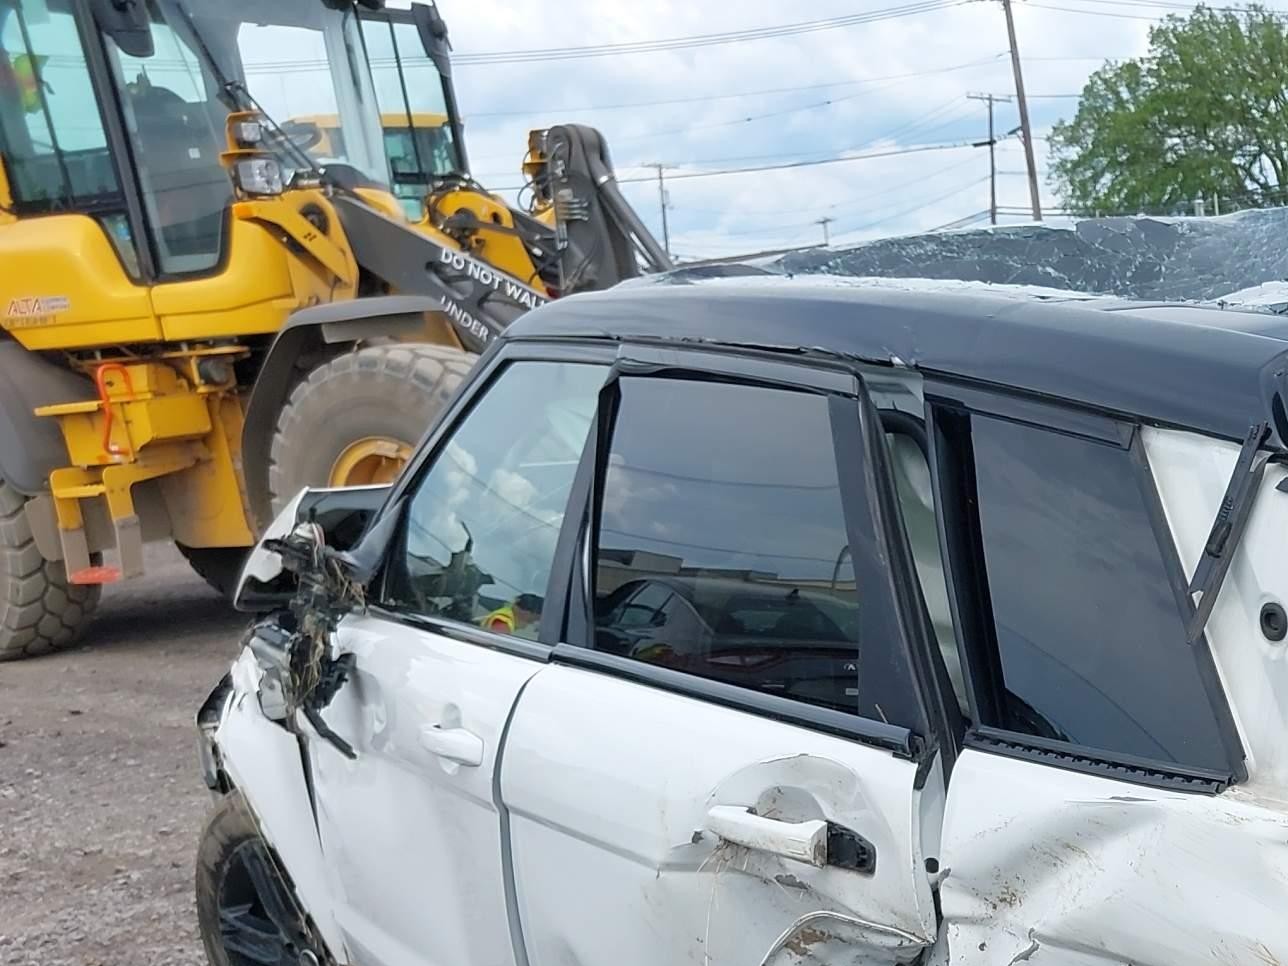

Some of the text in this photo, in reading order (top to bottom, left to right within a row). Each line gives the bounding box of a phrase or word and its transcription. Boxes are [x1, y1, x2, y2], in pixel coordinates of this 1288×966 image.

[441, 247, 546, 310] DO NOT WAL
[440, 295, 490, 342] UNDER
